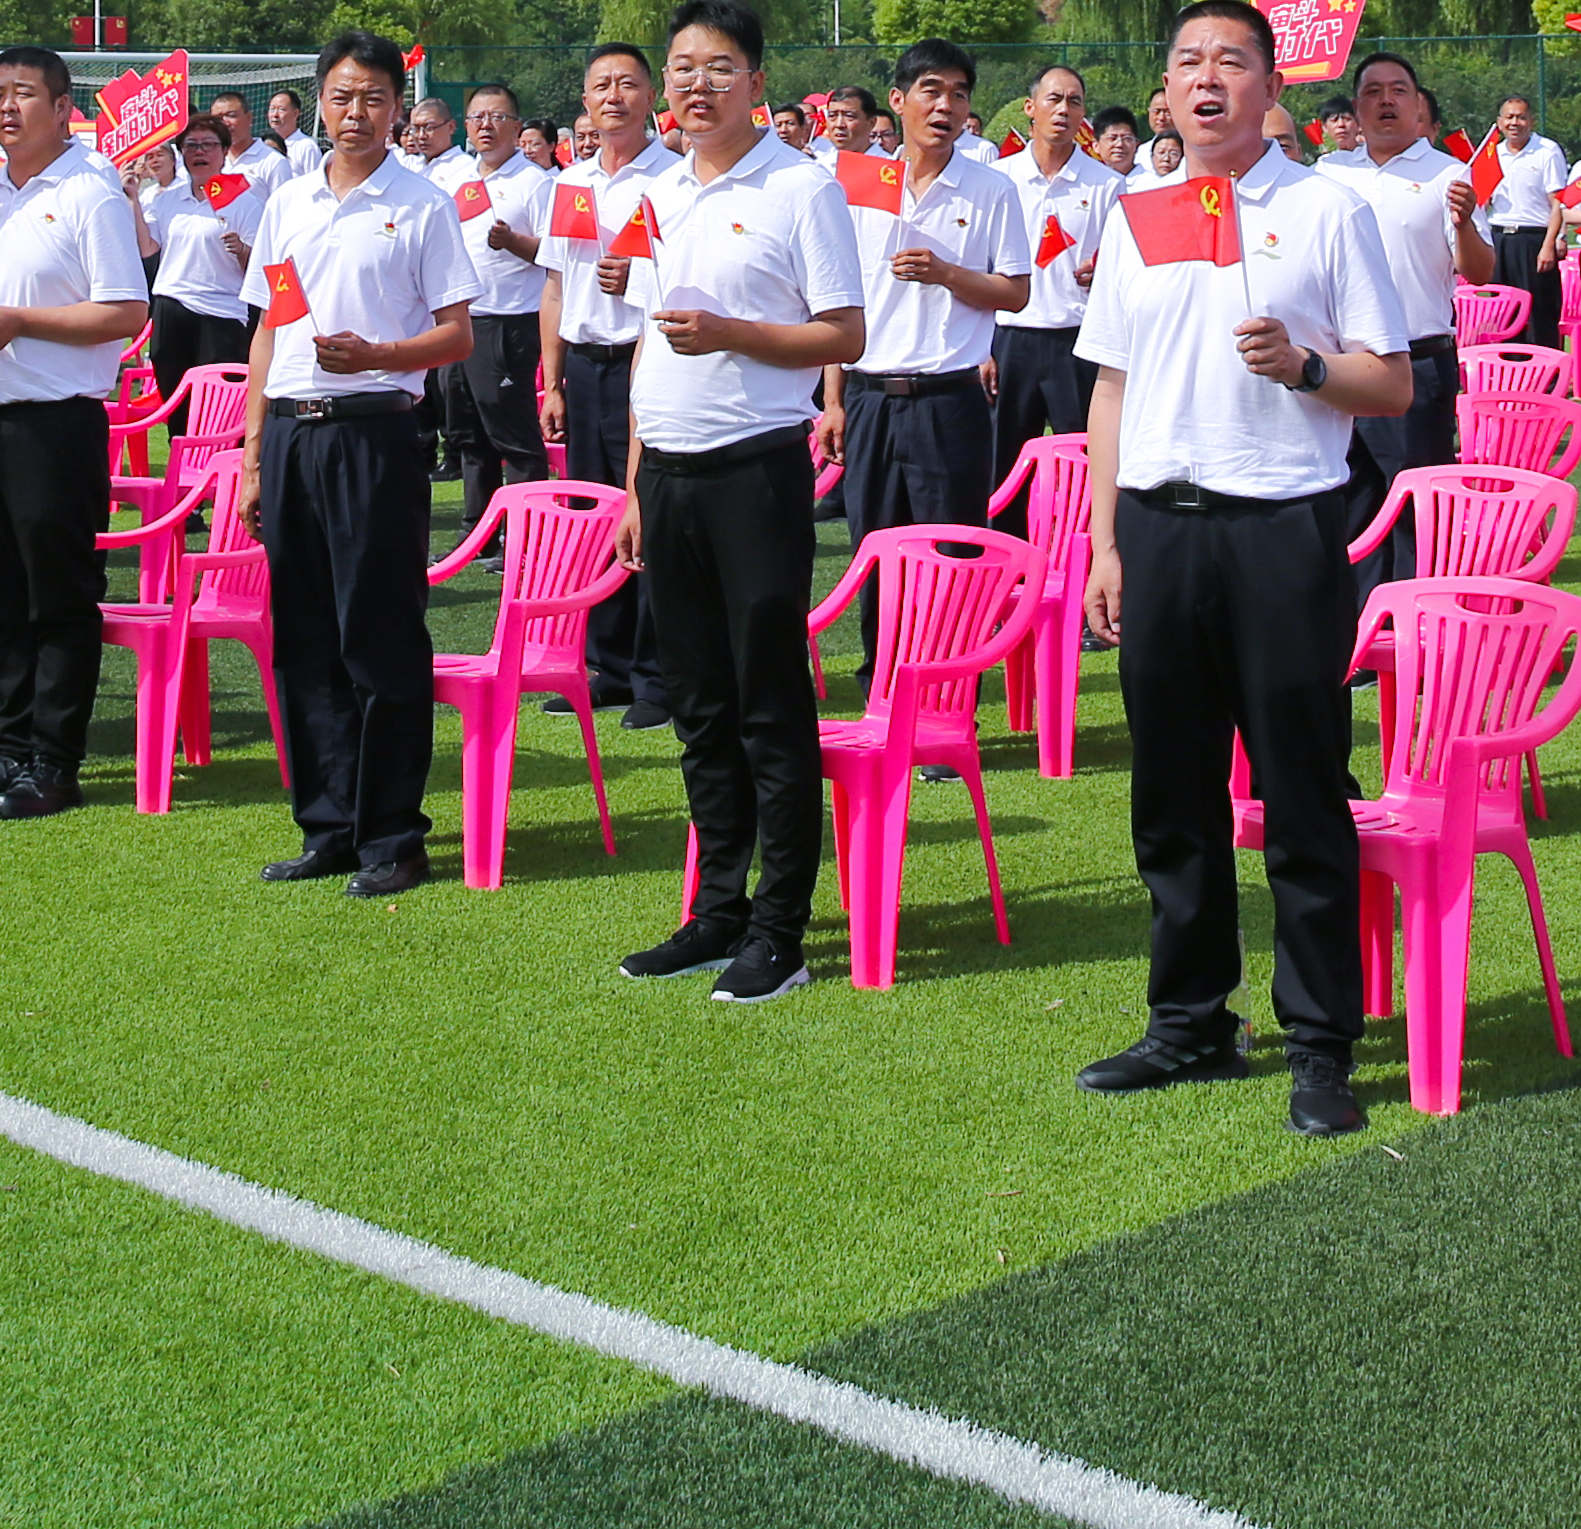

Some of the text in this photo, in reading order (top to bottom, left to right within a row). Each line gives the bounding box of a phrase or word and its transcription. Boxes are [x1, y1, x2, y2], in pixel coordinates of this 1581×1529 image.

[1274, 18, 1343, 64] 时代
[101, 88, 179, 160] 新时代
